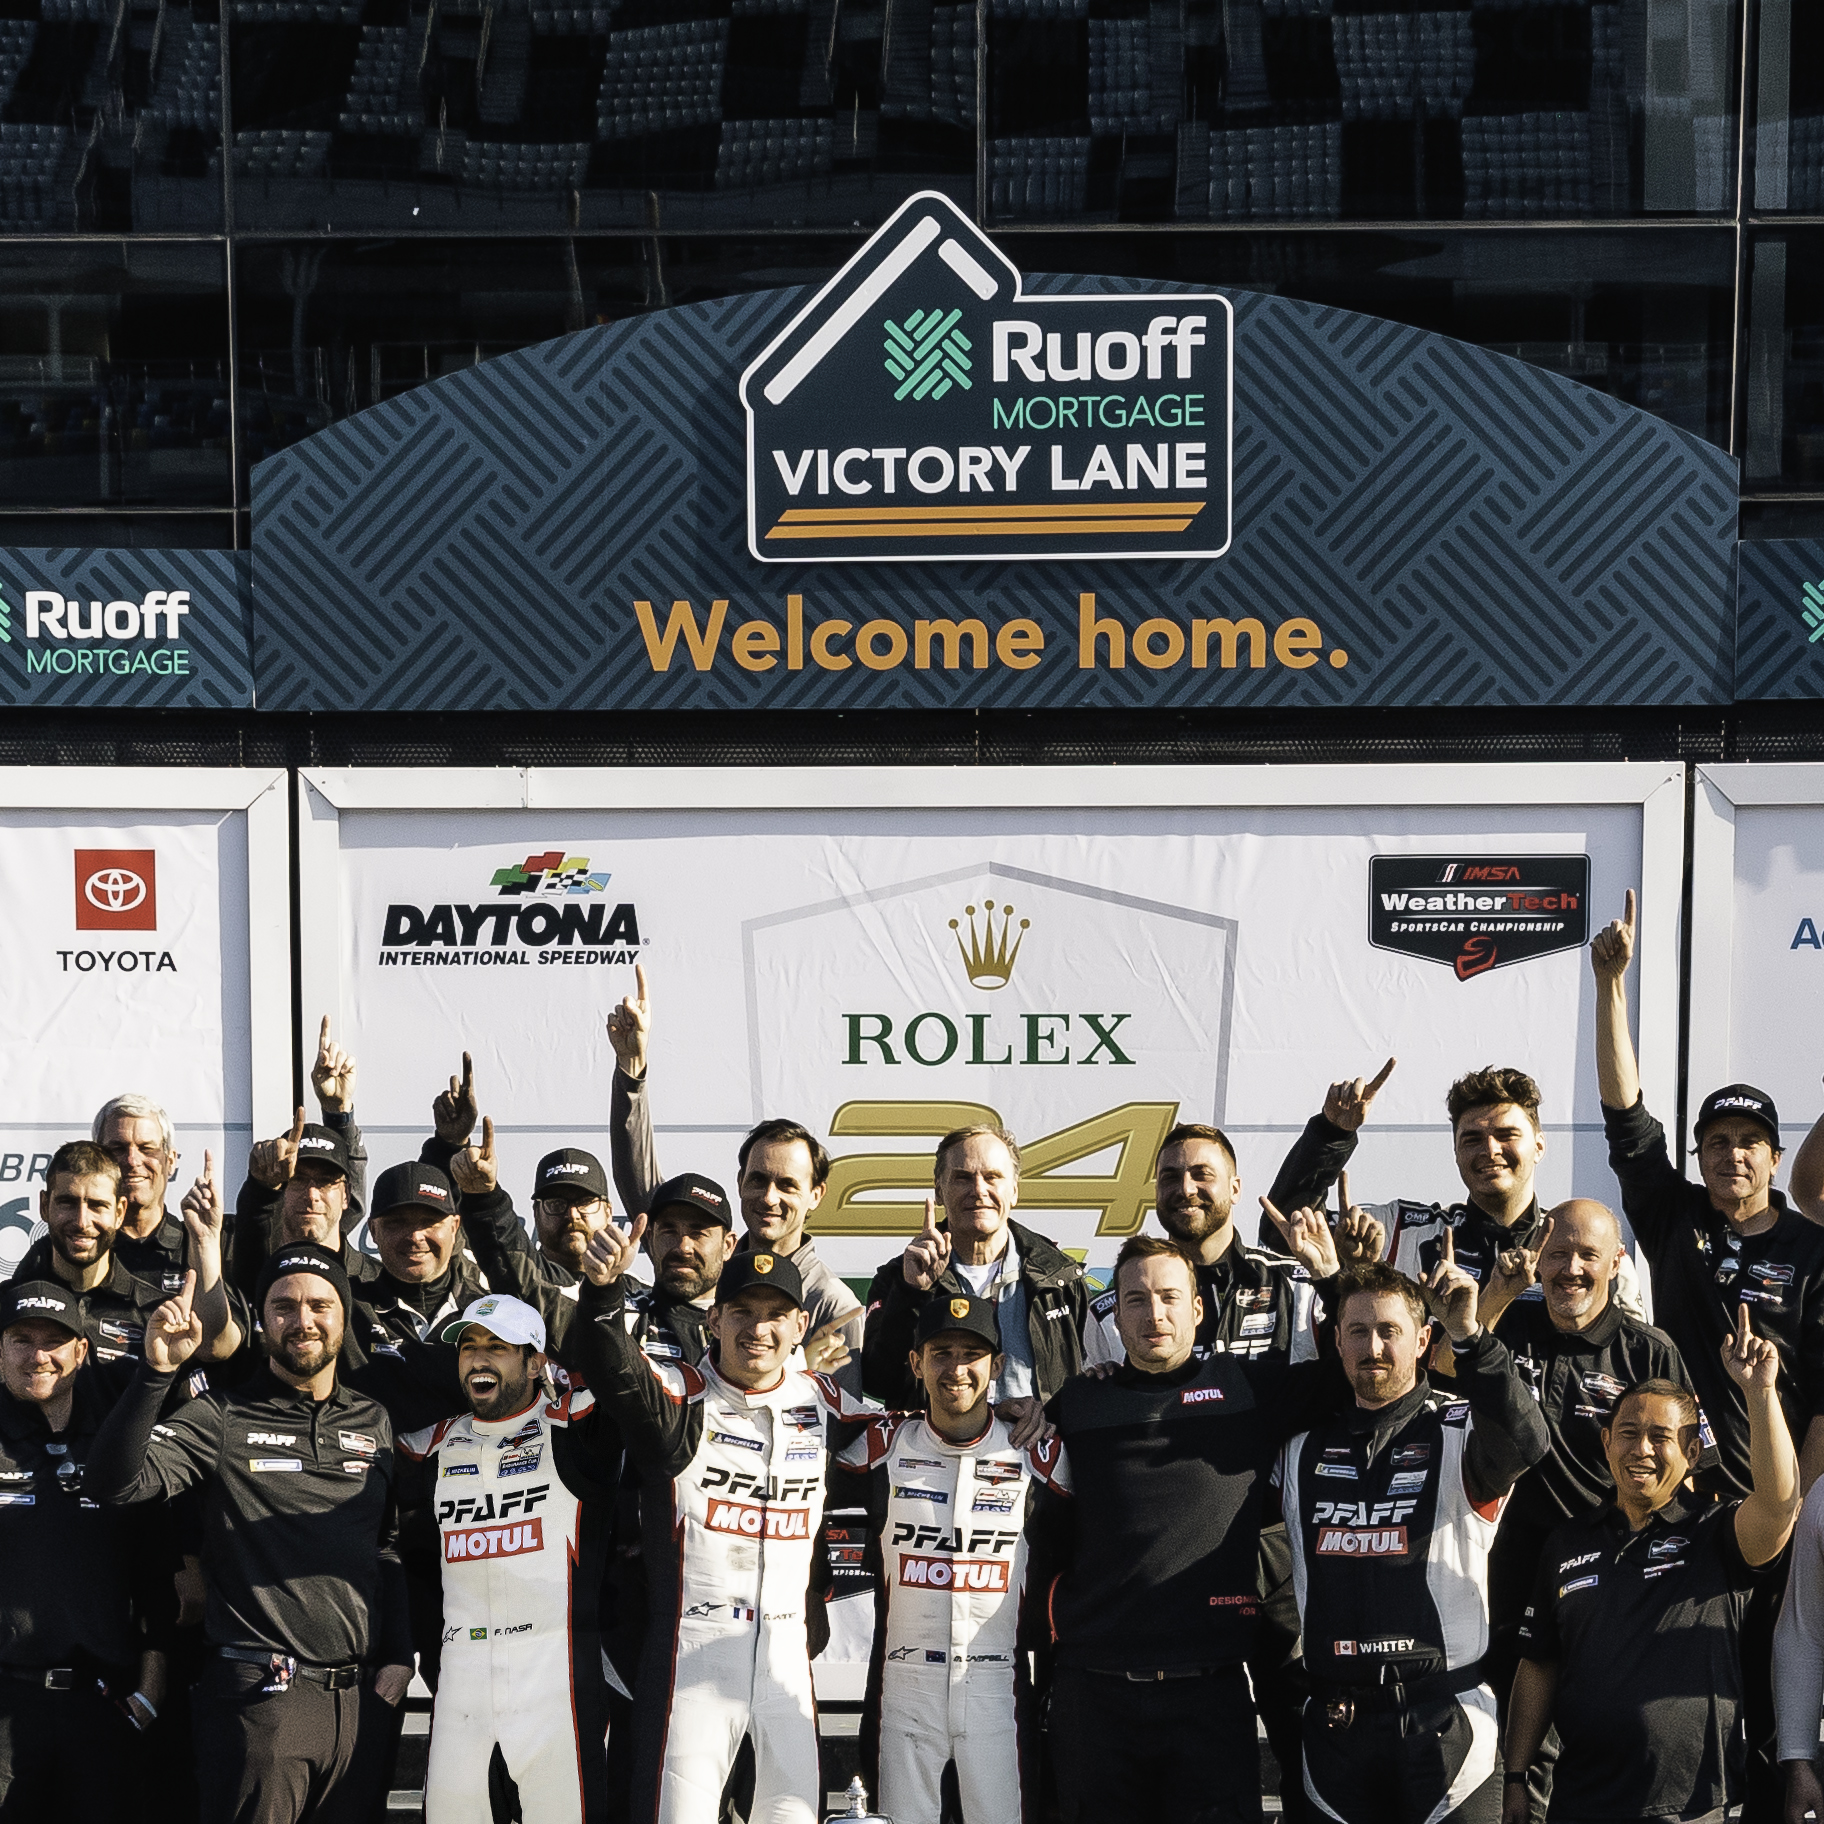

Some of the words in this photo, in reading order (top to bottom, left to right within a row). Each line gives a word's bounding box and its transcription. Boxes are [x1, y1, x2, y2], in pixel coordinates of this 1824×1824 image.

[992, 316, 1207, 383] Ruoff
[993, 394, 1205, 430] MORTGAGE
[773, 444, 1031, 496] VICTORY
[1051, 442, 1208, 491] LANE
[25, 590, 190, 640] Ruoff
[633, 594, 1045, 672] Welcome
[1079, 593, 1349, 671] home.
[26, 647, 190, 676] MORTGAGE
[1462, 866, 1521, 881] IMSA
[1381, 892, 1577, 911] WeatherTech
[381, 902, 640, 947] DAYTONA
[56, 949, 177, 973] TOYOTA
[378, 950, 530, 966] INTERNATIONAL
[538, 950, 639, 966] SPEEDWAY
[841, 1011, 1137, 1067] ROLEX
[1182, 1389, 1224, 1403] MOTUL
[700, 1465, 820, 1502] PFAFF
[438, 1484, 550, 1525] PFAFF
[711, 1503, 808, 1537] MOTUL
[1312, 1499, 1418, 1526] PFAFF
[446, 1524, 538, 1559] MOTUL
[891, 1522, 1019, 1553] PFAFF
[1320, 1530, 1404, 1553] MOTUL
[902, 1558, 1005, 1589] MOTUL
[1359, 1638, 1415, 1654] WHITEY
